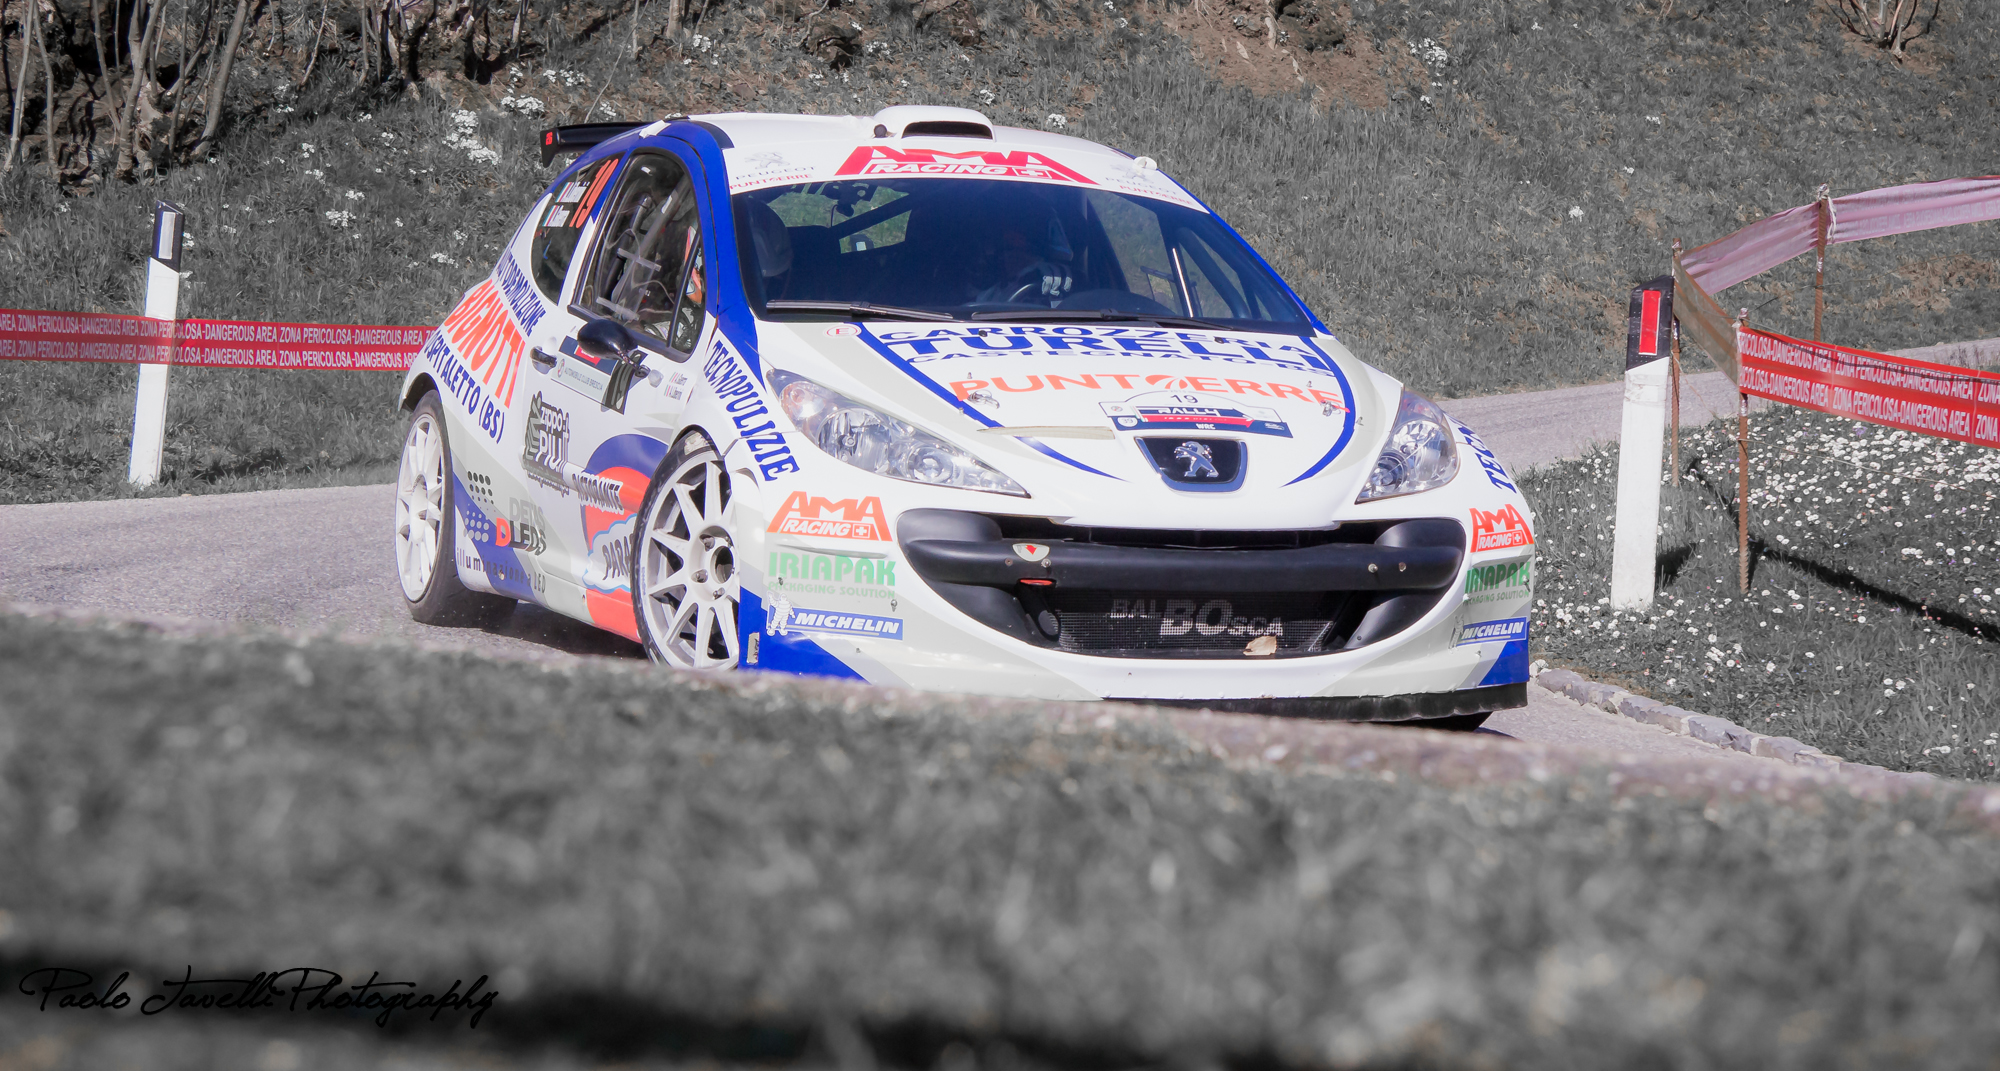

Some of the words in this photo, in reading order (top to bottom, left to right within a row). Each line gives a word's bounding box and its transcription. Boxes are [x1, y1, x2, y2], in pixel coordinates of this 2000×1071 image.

[735, 166, 814, 180] PEUGEOT
[834, 146, 1102, 185] AMA
[871, 163, 1007, 175] RACING
[18, 315, 37, 332] ZONA
[121, 320, 139, 336] AREA
[255, 326, 278, 343] AREA
[279, 327, 301, 343] ZONA
[302, 327, 401, 345] PERICOLOSA-DANGEROUS
[402, 330, 423, 346] AREA
[444, 279, 526, 408] BIGNOTTI
[879, 326, 1316, 356] CARROZZERIA
[255, 349, 277, 365] AREA
[279, 350, 301, 367] ZONA
[302, 350, 401, 368] PERICOLOSA-DANGEROUS
[885, 336, 1333, 371] TURELLI
[1812, 348, 1831, 373] AREA
[1835, 352, 1855, 376] ZONA
[703, 340, 800, 481] TECNOPULIZIE
[1158, 407, 1219, 417] RALLY
[1170, 394, 1198, 404] 19
[1810, 382, 1828, 407] AREA
[1833, 386, 1852, 411] ZONA
[1948, 409, 1970, 437] AREA
[1975, 414, 1998, 442] ZONA
[479, 394, 505, 444] (BS)
[766, 491, 893, 542] AMA
[783, 519, 851, 536] RACING
[1469, 504, 1534, 553] AMA
[1478, 533, 1512, 549] RACING
[768, 552, 896, 586] IRIAPAK
[1464, 561, 1531, 594] IRIAPAK
[840, 587, 895, 599] SOLUTION
[1497, 589, 1529, 601] SOLUTION
[795, 613, 899, 634] MICHELIN
[1461, 622, 1524, 640] MICHELIN
